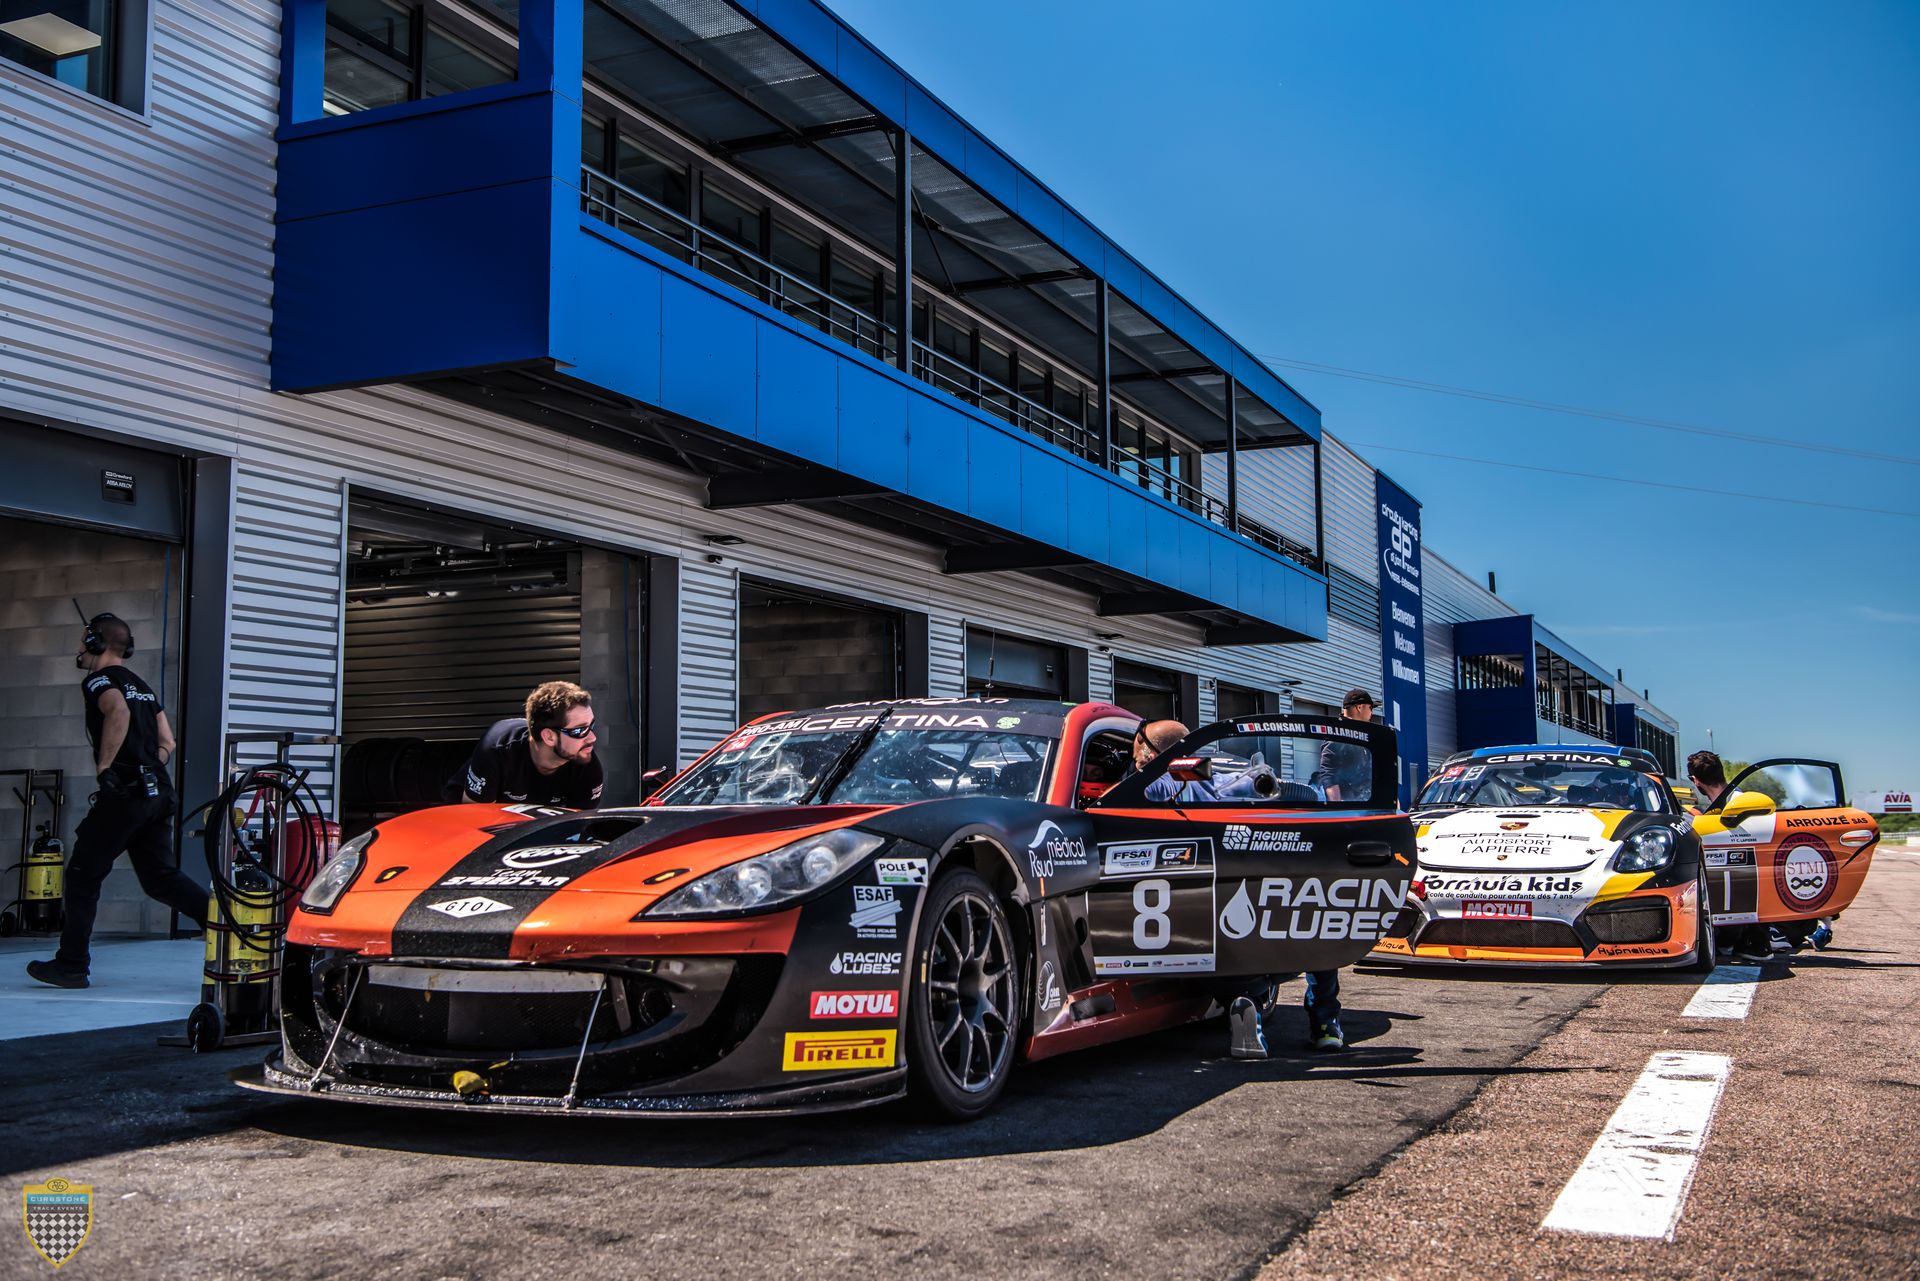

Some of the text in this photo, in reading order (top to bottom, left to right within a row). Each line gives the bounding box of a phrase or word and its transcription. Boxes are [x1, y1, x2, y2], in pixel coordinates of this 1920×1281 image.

[737, 719, 804, 738] PRO-AM
[1486, 753, 1614, 766] CERTINA
[1252, 831, 1302, 842] FIGUIERE
[1435, 832, 1590, 842] PORSCHE
[1465, 838, 1555, 846] AUTOSPORT
[1249, 841, 1314, 852] IMMOBILIER
[1461, 845, 1552, 856] LAPIERRE
[1787, 861, 1825, 875] STMI
[1527, 876, 1583, 893] kids
[855, 888, 893, 901] ESAF
[1455, 892, 1487, 900] conduite
[1132, 879, 1171, 950] 8
[1465, 902, 1529, 917] MOTUL
[843, 952, 902, 964] RACING
[843, 963, 892, 975] LUBES
[814, 993, 895, 1015] MOTUL
[793, 1037, 887, 1063] PIRELLI
